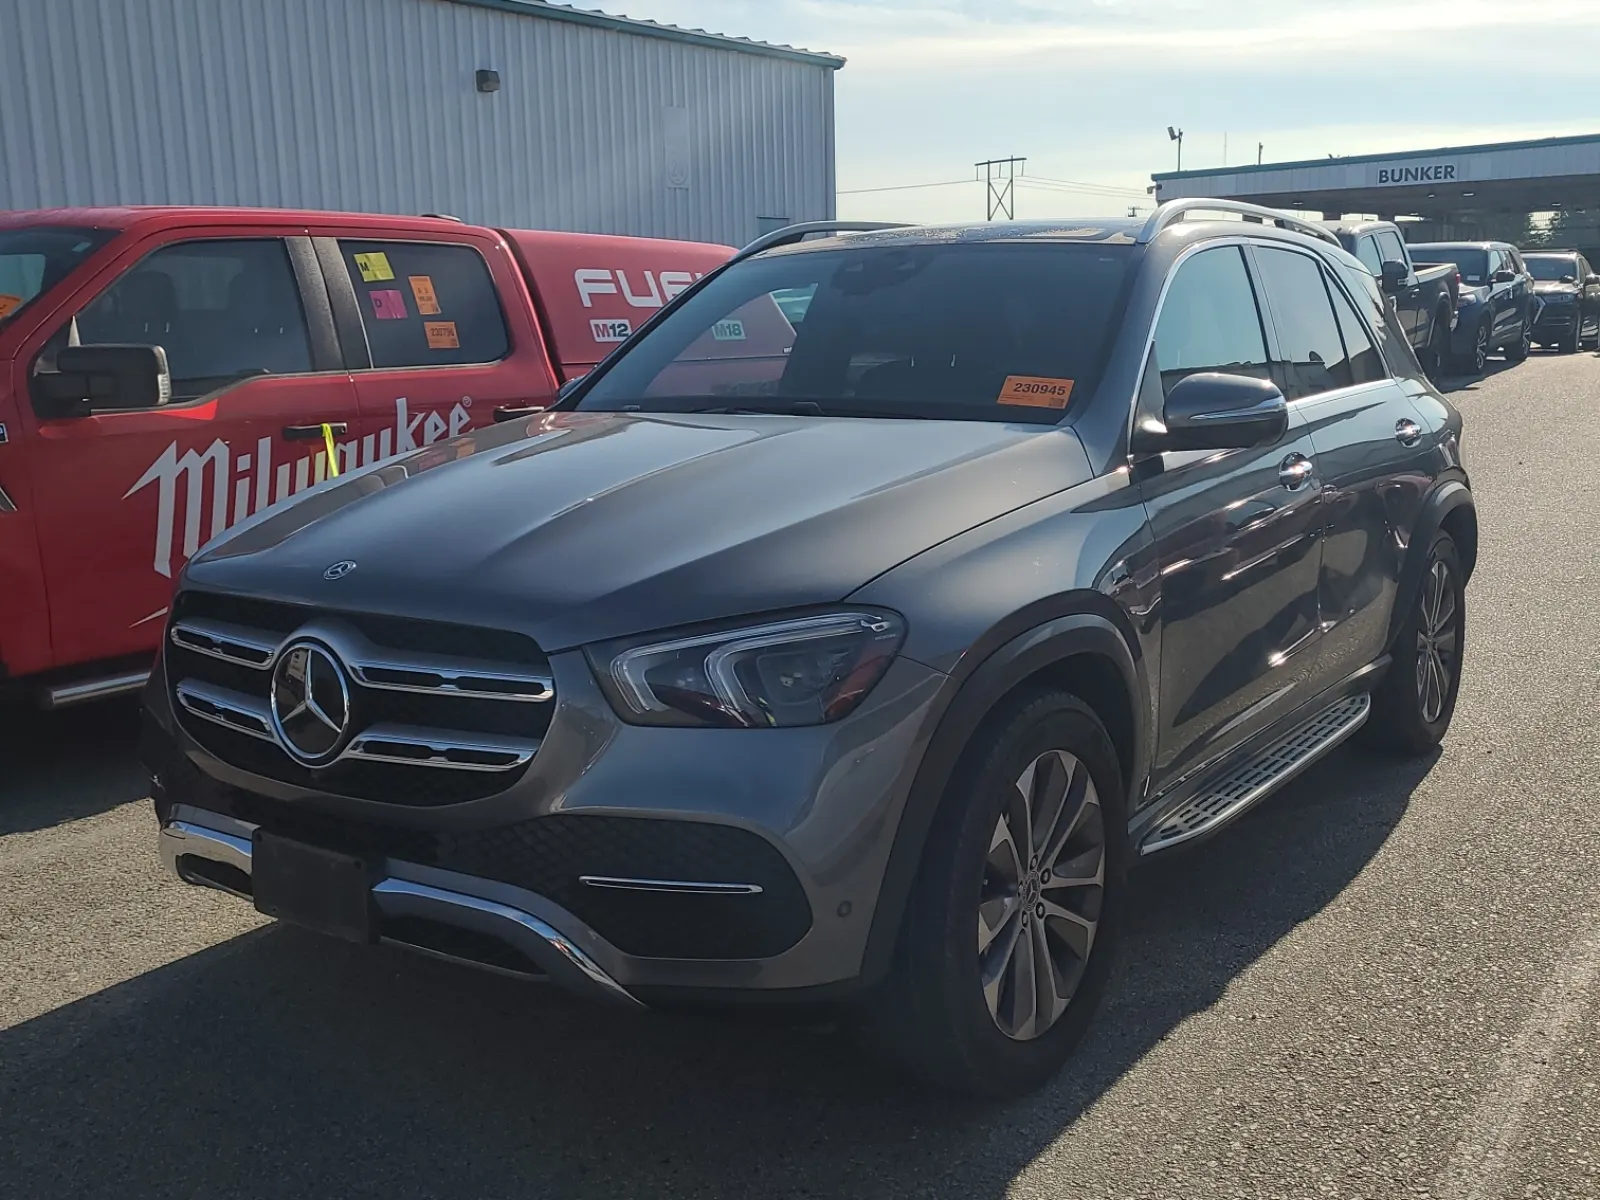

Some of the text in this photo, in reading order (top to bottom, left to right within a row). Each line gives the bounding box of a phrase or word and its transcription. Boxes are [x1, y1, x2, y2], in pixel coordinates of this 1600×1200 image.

[1378, 165, 1455, 184] BUNKER
[359, 262, 370, 273] M
[574, 268, 704, 308] FUE
[593, 323, 629, 339] M12
[714, 323, 742, 338] M18
[1013, 382, 1066, 396] 230945
